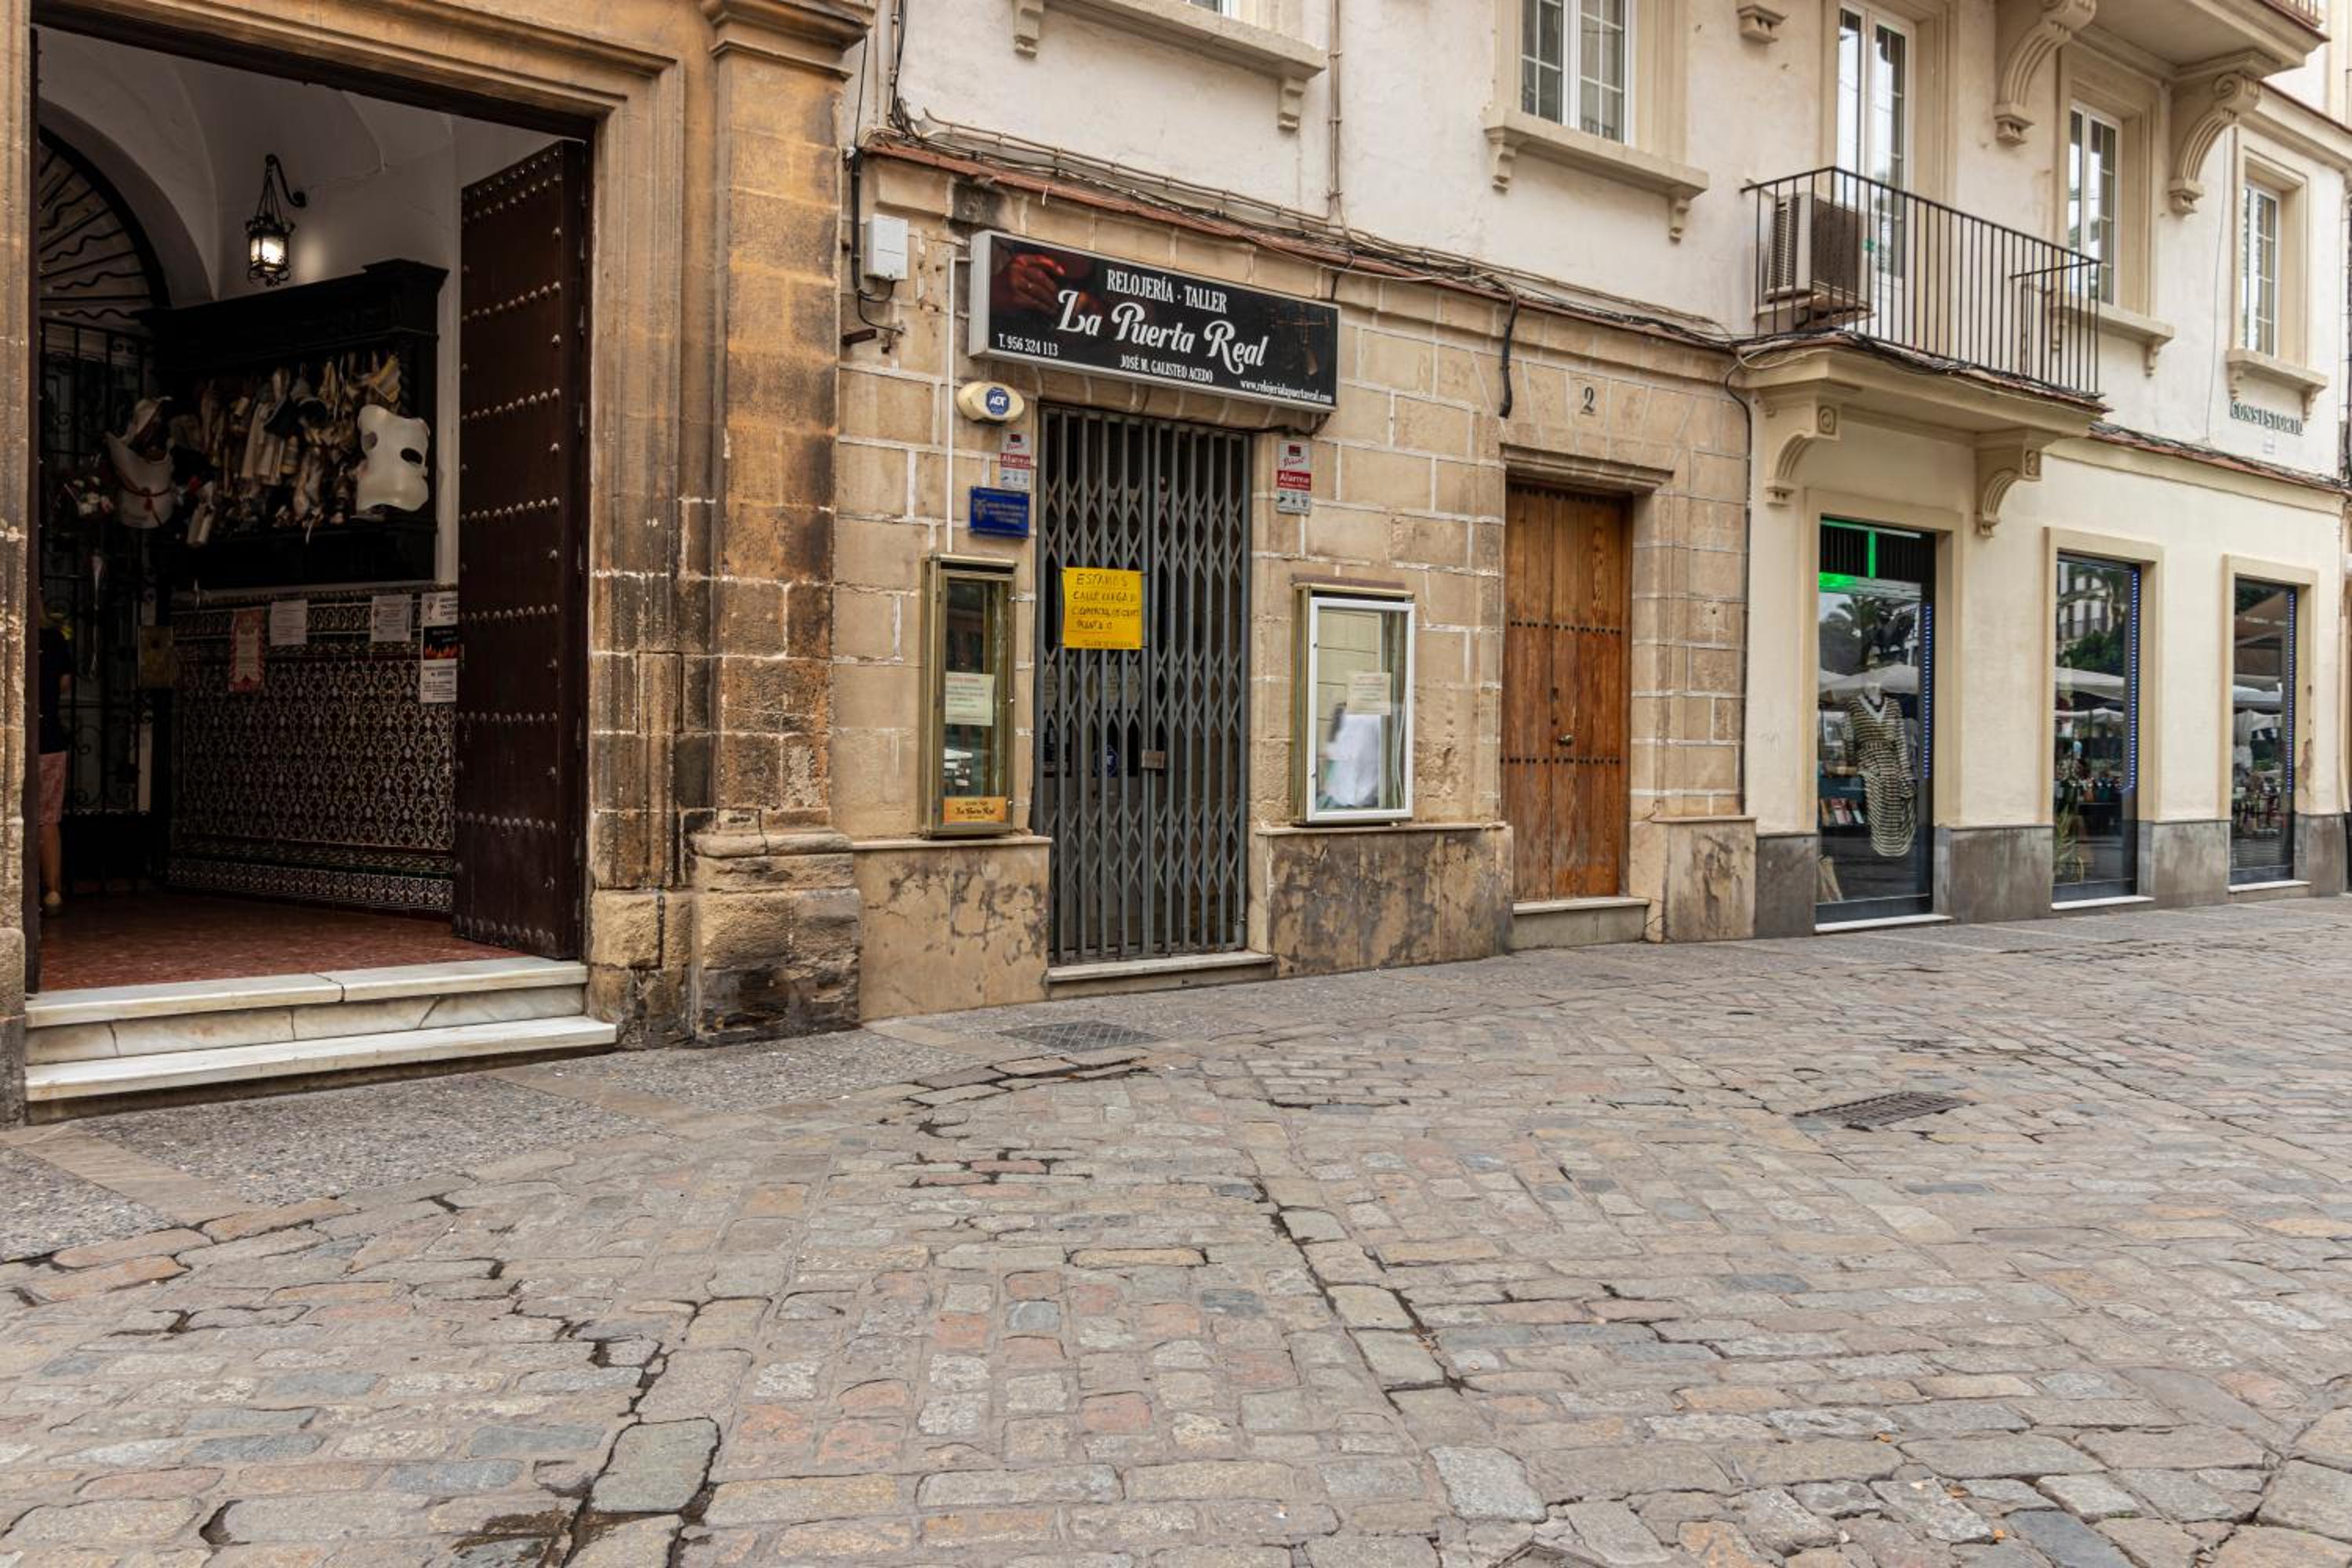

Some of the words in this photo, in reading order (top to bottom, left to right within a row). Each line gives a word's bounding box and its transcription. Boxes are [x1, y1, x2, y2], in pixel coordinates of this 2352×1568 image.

[1107, 270, 1173, 303] RELOJERÍA
[1184, 285, 1227, 314] TALLER
[1007, 335, 1024, 350] 956
[1025, 338, 1041, 354] 324
[1043, 341, 1059, 357] 113
[1057, 289, 1102, 336] La
[1111, 302, 1196, 354] Puerta
[1204, 319, 1269, 375] Real
[1120, 354, 1139, 370] JOSÉ
[1189, 367, 1213, 383] ACEDO
[1581, 387, 1595, 416] 2
